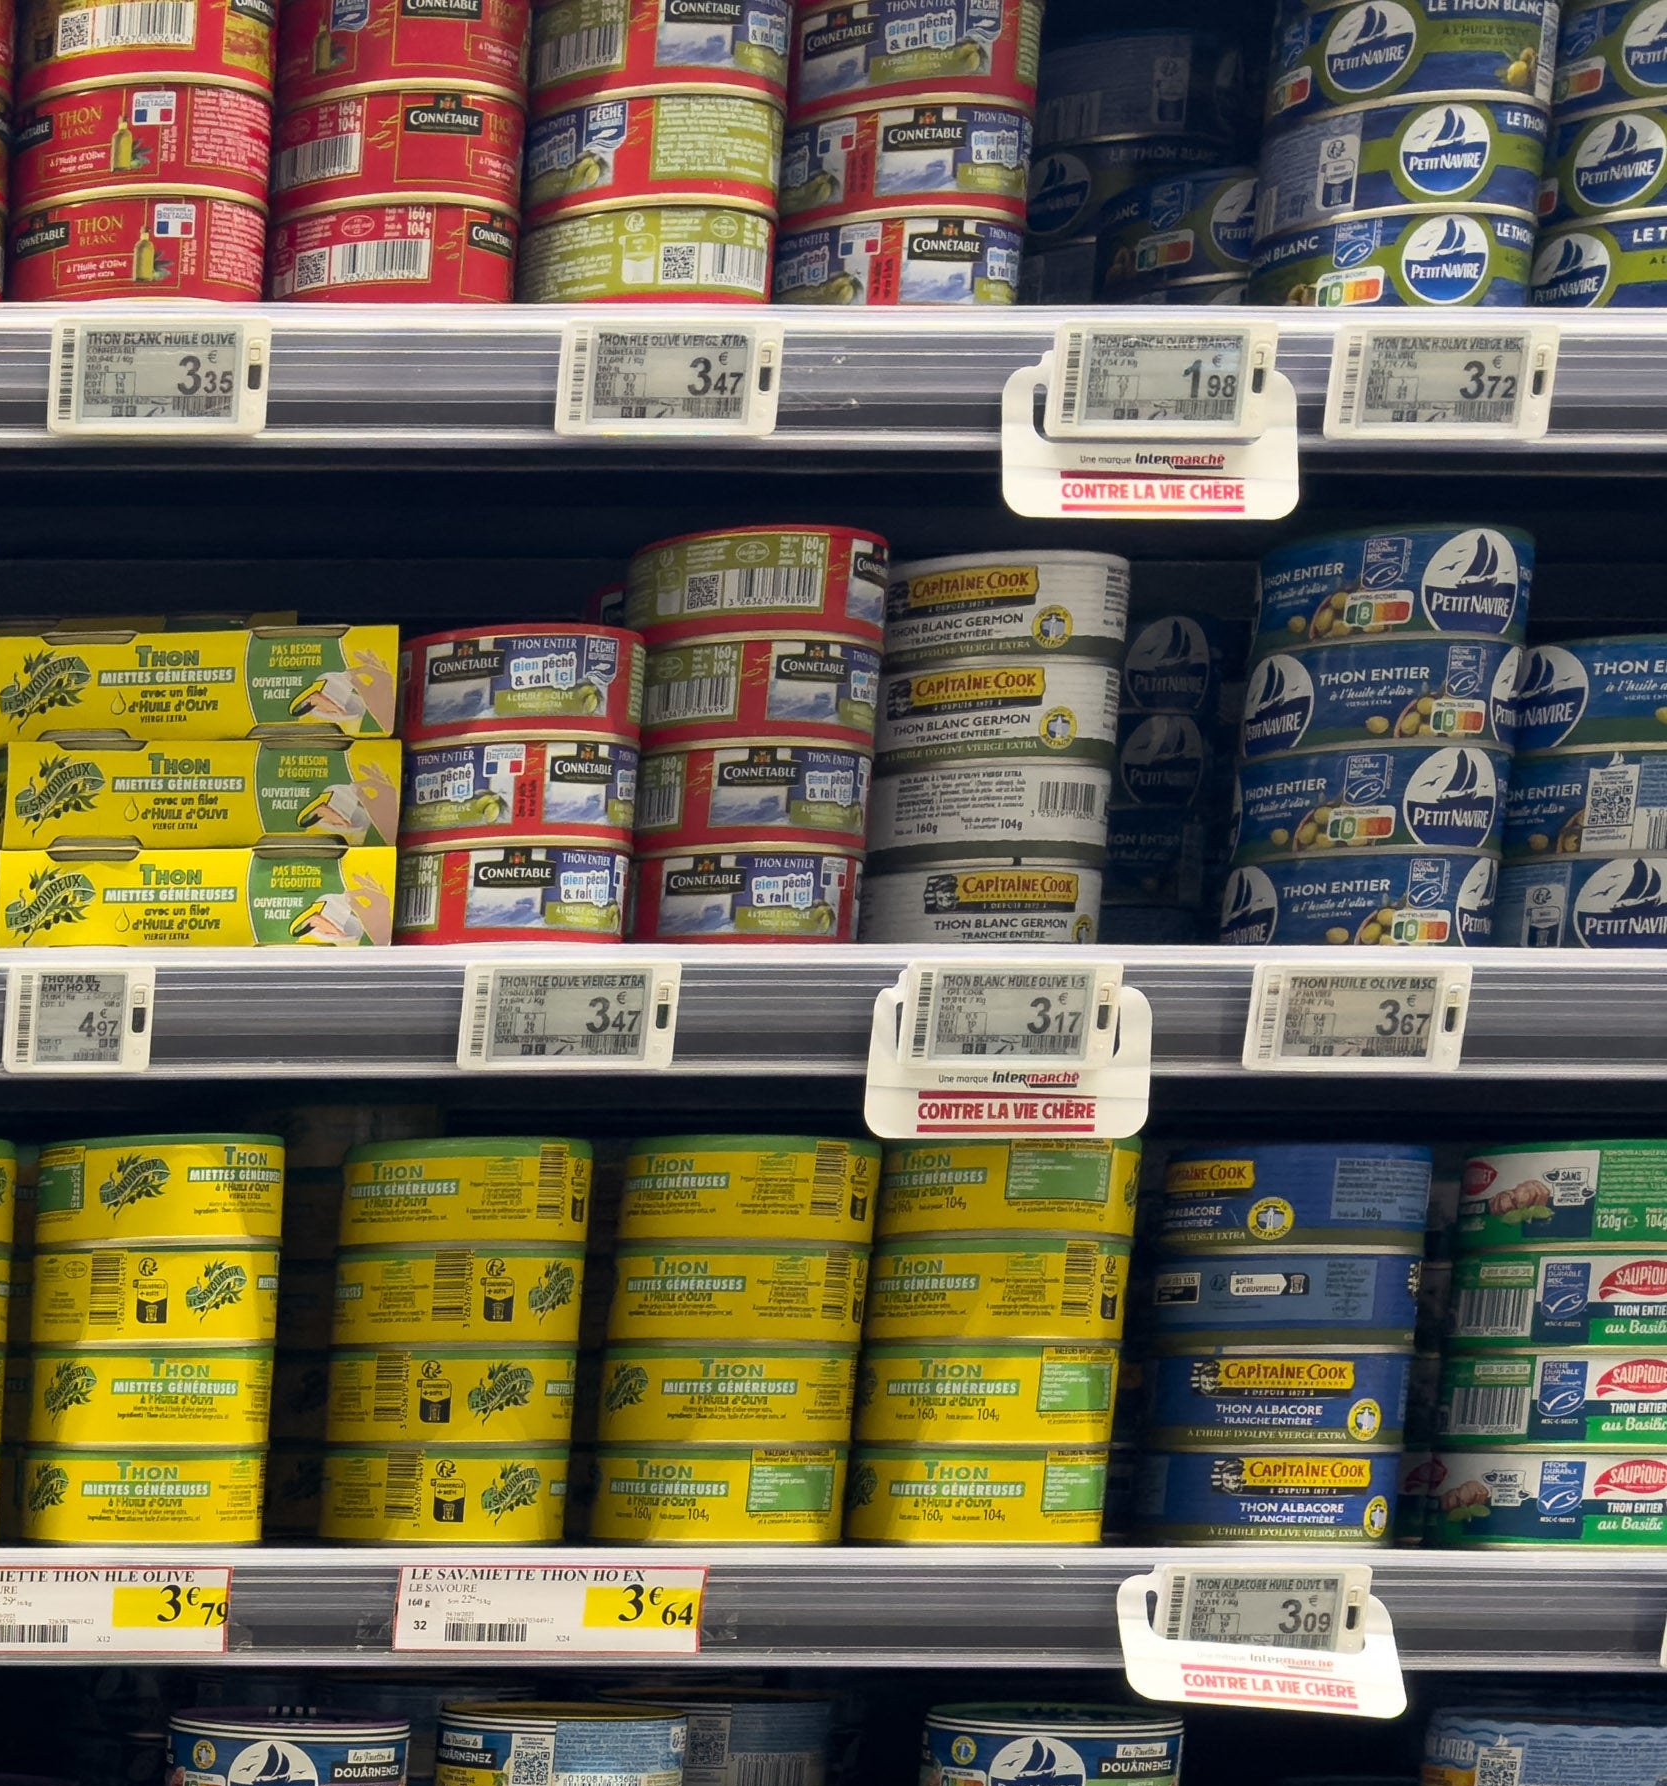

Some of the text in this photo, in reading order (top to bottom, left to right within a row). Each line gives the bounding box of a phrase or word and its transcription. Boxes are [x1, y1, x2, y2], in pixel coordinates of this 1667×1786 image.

[407, 222, 430, 236] 104g
[1062, 480, 1245, 501] CONTRE LA VIE CHÈRE
[152, 1360, 210, 1377] THON
[170, 1380, 236, 1394] GÉNÉREUSES
[411, 1569, 428, 1582] LE
[409, 1584, 421, 1592] LE
